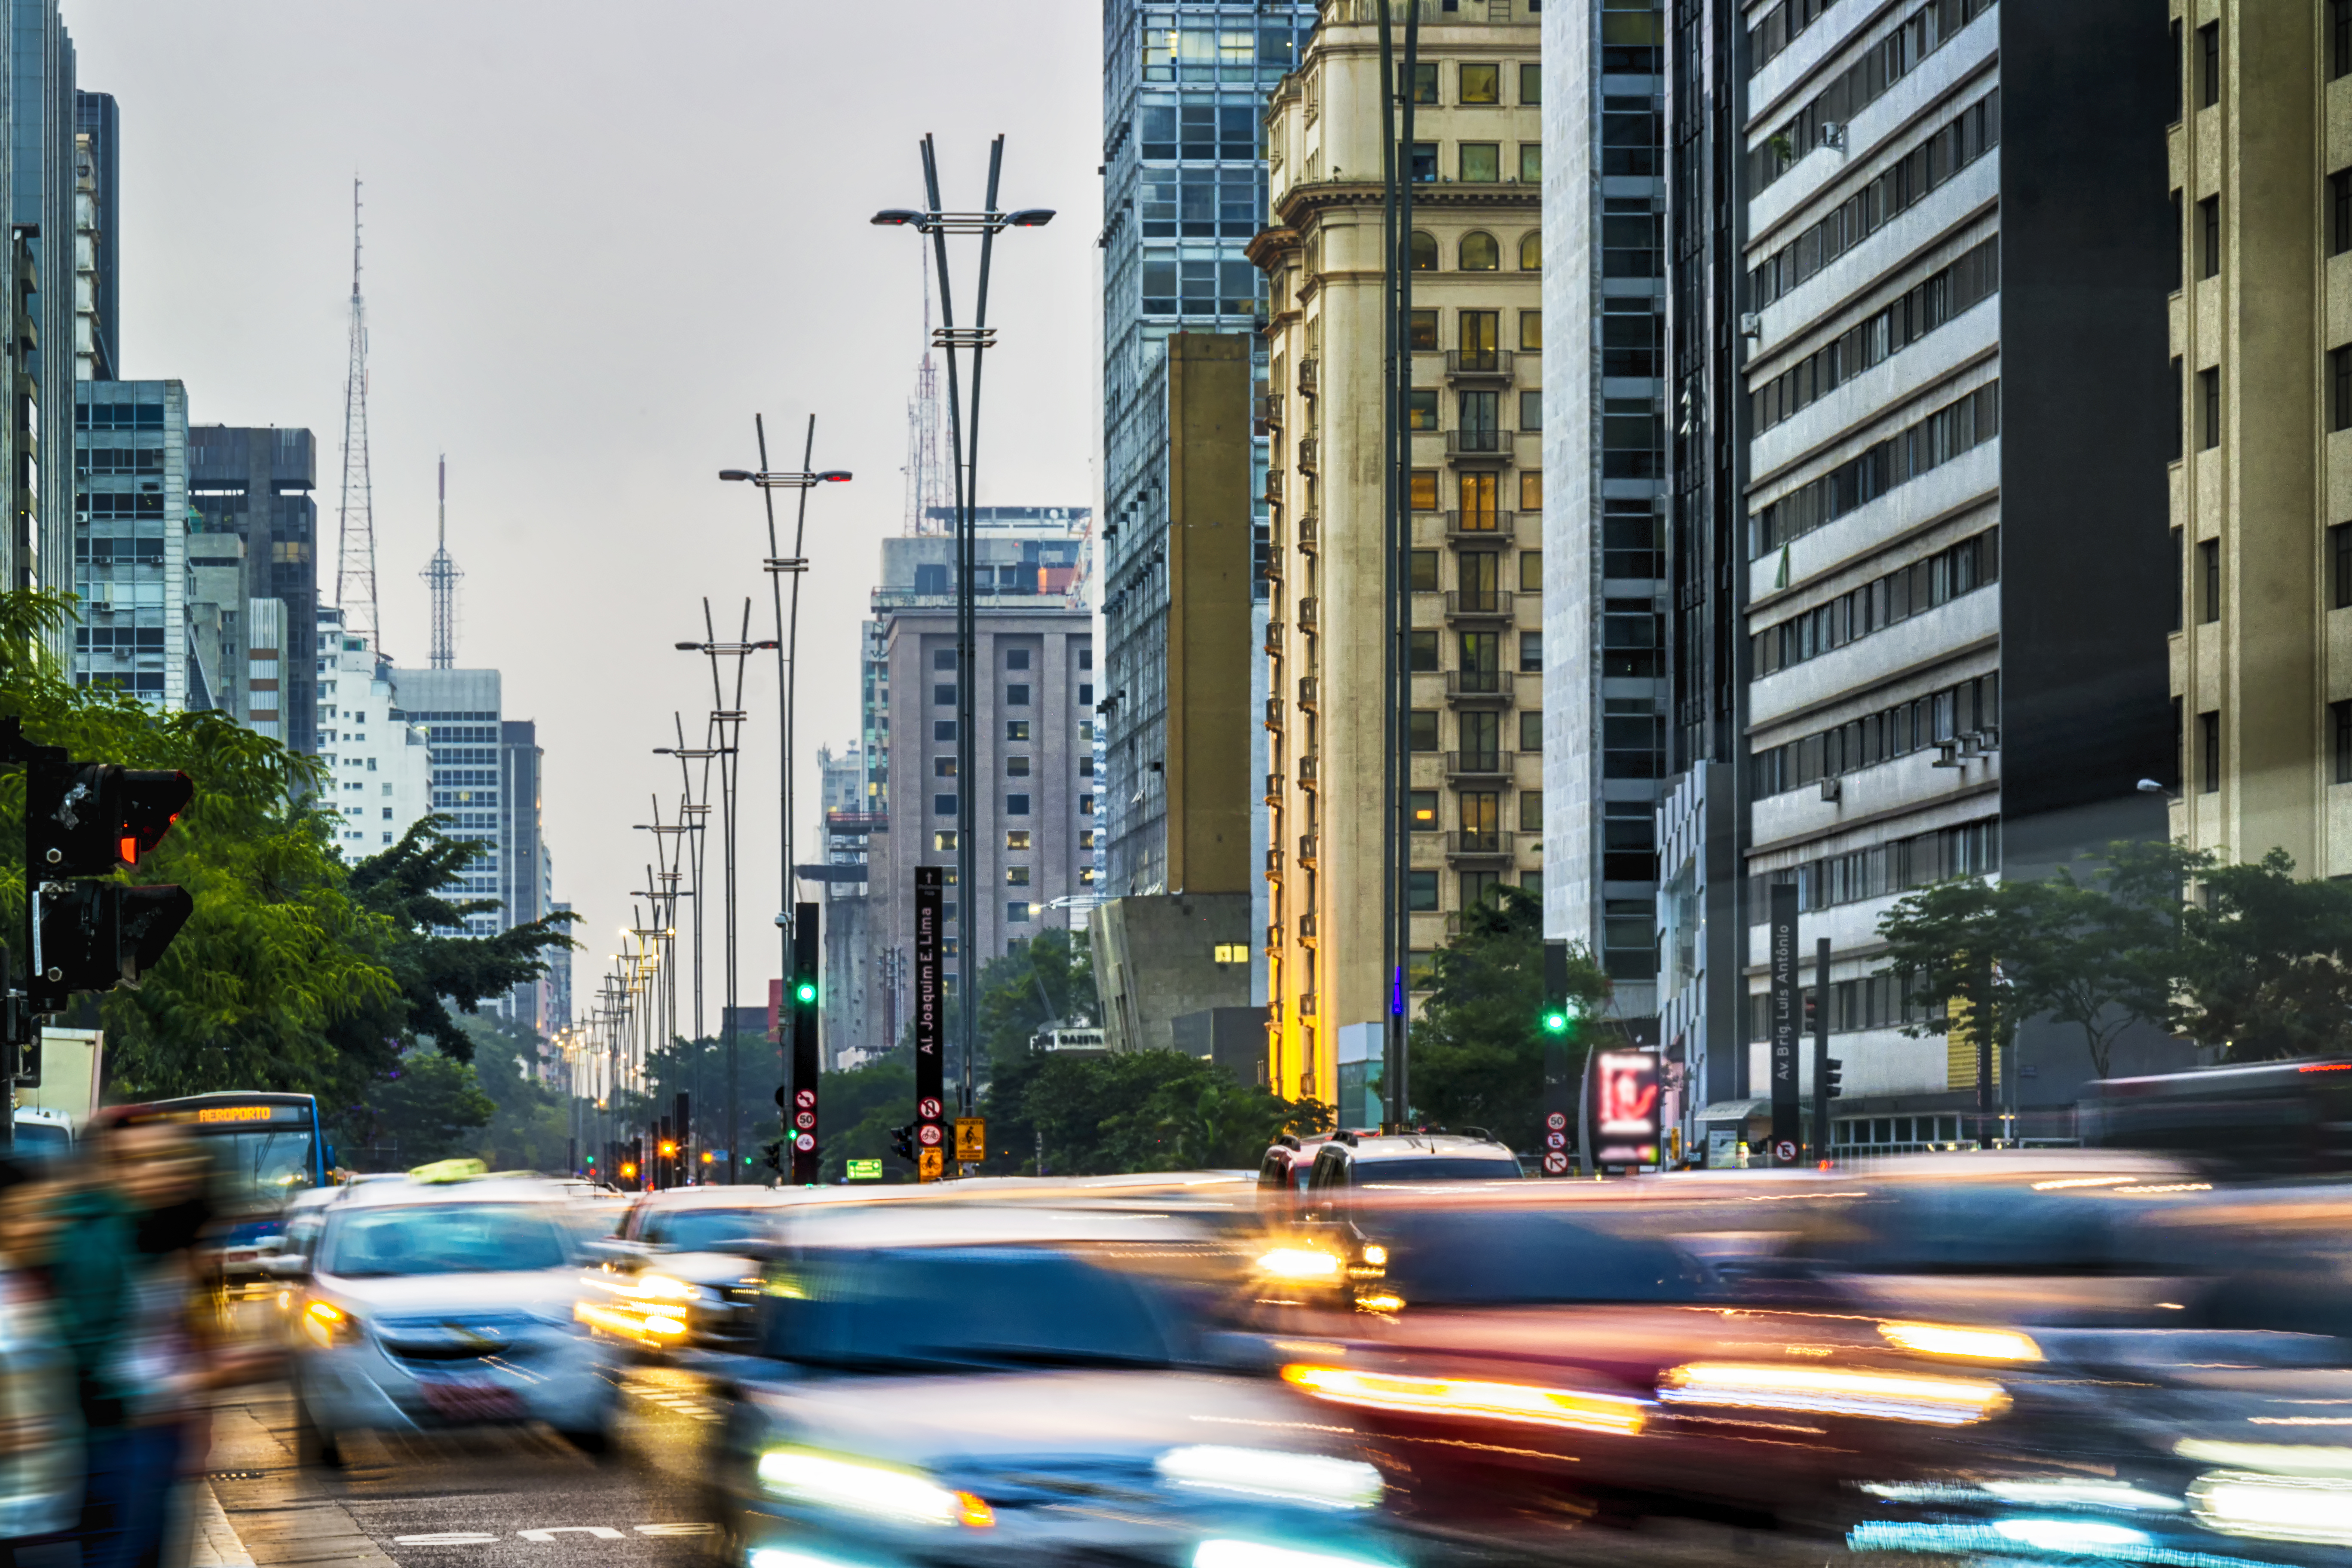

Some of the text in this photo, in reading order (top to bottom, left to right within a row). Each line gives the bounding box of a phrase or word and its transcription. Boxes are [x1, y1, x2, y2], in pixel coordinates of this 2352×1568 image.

[1776, 925, 1789, 983] Antônio
[919, 908, 935, 1054] Al. Joaquim E. Lima
[1776, 1023, 1792, 1056] Brig.
[1777, 1060, 1789, 1080] Av.
[199, 1107, 270, 1122] AEROPORTO
[799, 1115, 813, 1124] 50
[1550, 1117, 1563, 1125] 50
